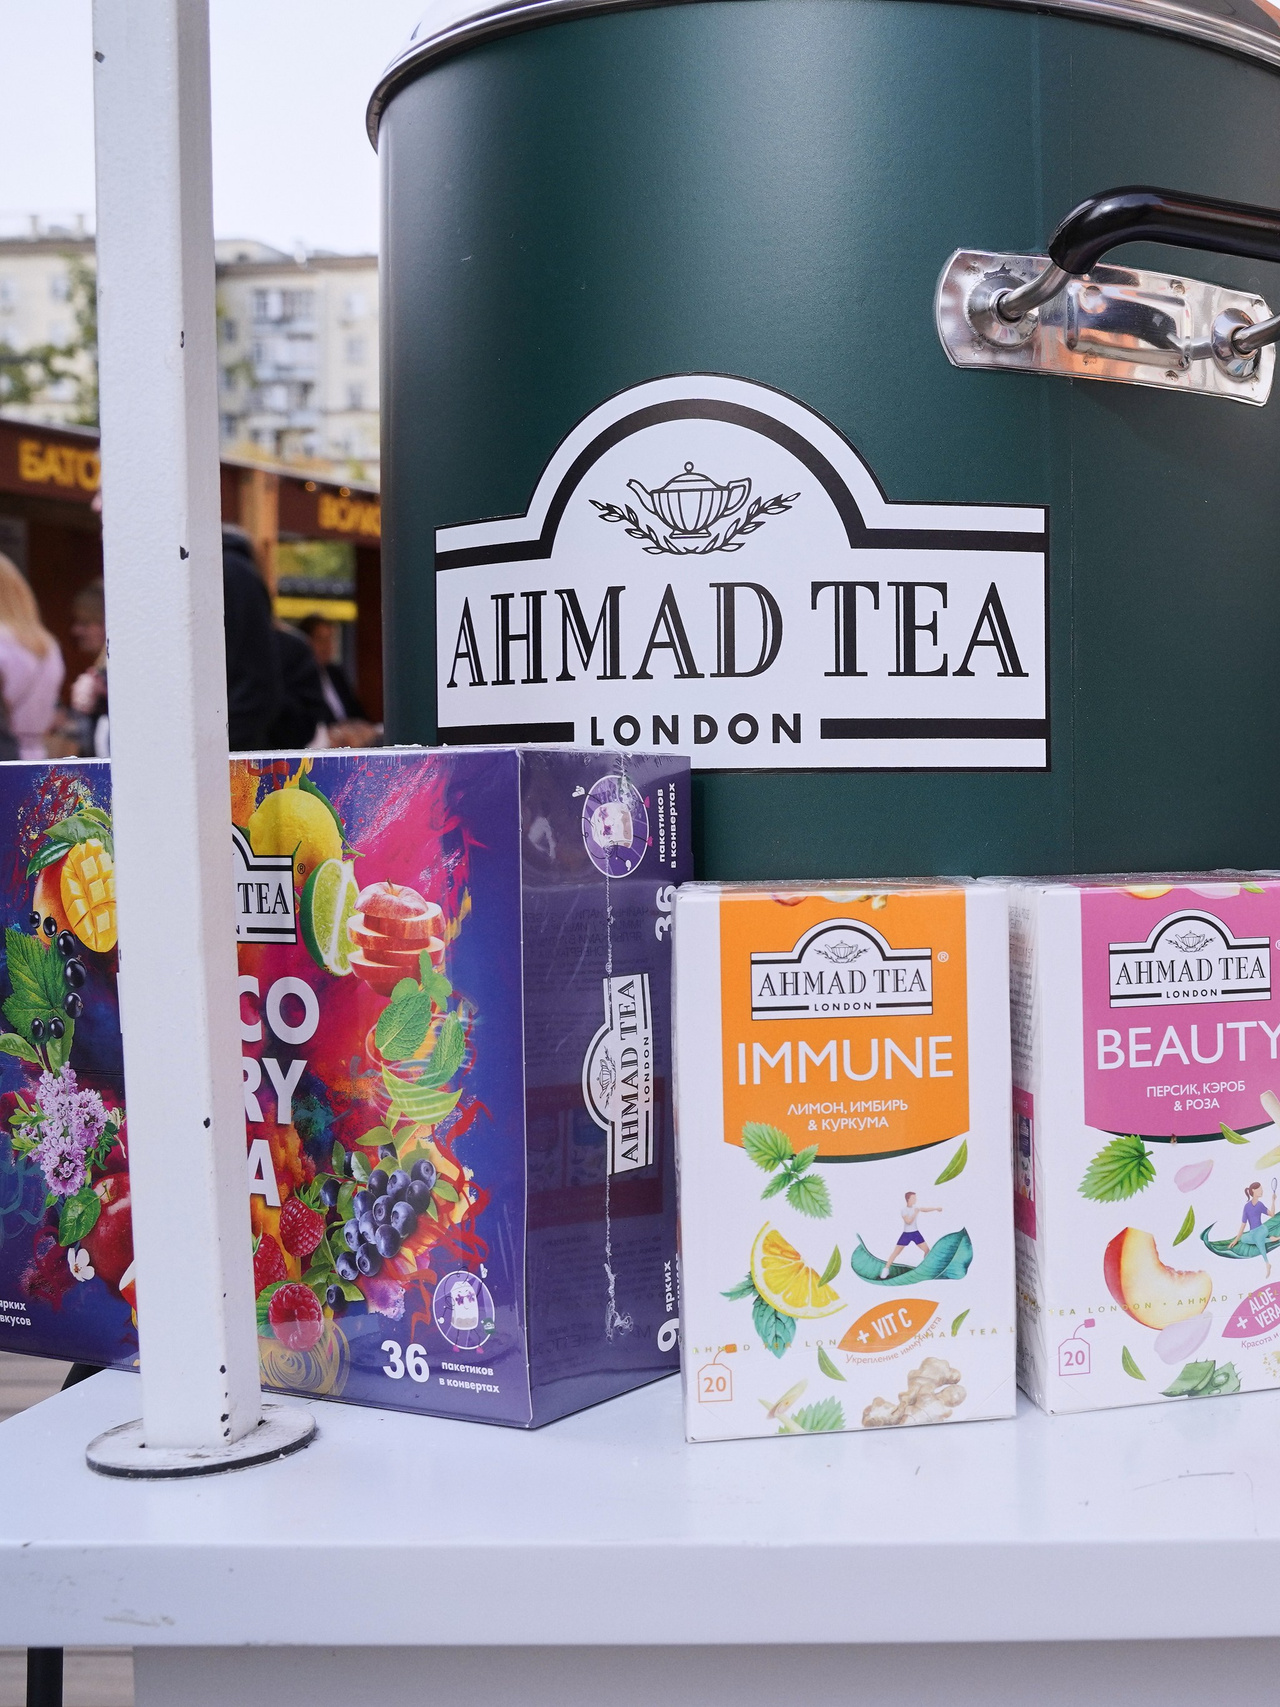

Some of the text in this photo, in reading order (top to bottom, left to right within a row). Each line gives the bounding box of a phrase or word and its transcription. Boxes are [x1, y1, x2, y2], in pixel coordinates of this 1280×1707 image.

[20, 439, 100, 490] БАТО
[447, 581, 1029, 688] AHMAD TEA
[591, 713, 801, 747] LONDON
[657, 788, 666, 863] пакетиков
[669, 782, 678, 858] конвертах
[238, 883, 290, 914] TEA
[758, 968, 927, 997] AHMAD TEA
[1116, 956, 1266, 985] AHMAD TEA
[814, 1002, 872, 1012] LONDON
[1166, 988, 1218, 998] LONDON
[238, 975, 319, 1044] CO
[618, 979, 639, 1164] AHMAD TEA
[738, 1035, 953, 1085] IMMUNE
[242, 1056, 307, 1124] RY
[1147, 1081, 1245, 1097] ПЕРСИК, КЭРОБ
[787, 1099, 908, 1116] ЛИМОН, ИМБИРЬ
[1173, 1098, 1220, 1111] & РОЗА
[807, 1117, 889, 1131] & КУРКУМА
[247, 1139, 281, 1207] A
[664, 1260, 675, 1312] ярких
[1177, 1295, 1228, 1305] AHMAD
[1249, 1287, 1276, 1314] ALOE
[0, 1314, 31, 1327] вкусов
[1088, 1302, 1151, 1313] LONDON
[871, 1312, 898, 1339] VIT
[899, 1307, 912, 1328] C
[846, 1316, 942, 1365] Укрепление иммунитета
[1241, 1336, 1272, 1349] Красота
[381, 1340, 430, 1383] 36
[441, 1361, 494, 1376] пакетиков
[1064, 1350, 1085, 1366] 20
[439, 1377, 500, 1393] в конвертах
[703, 1376, 727, 1393] 20
